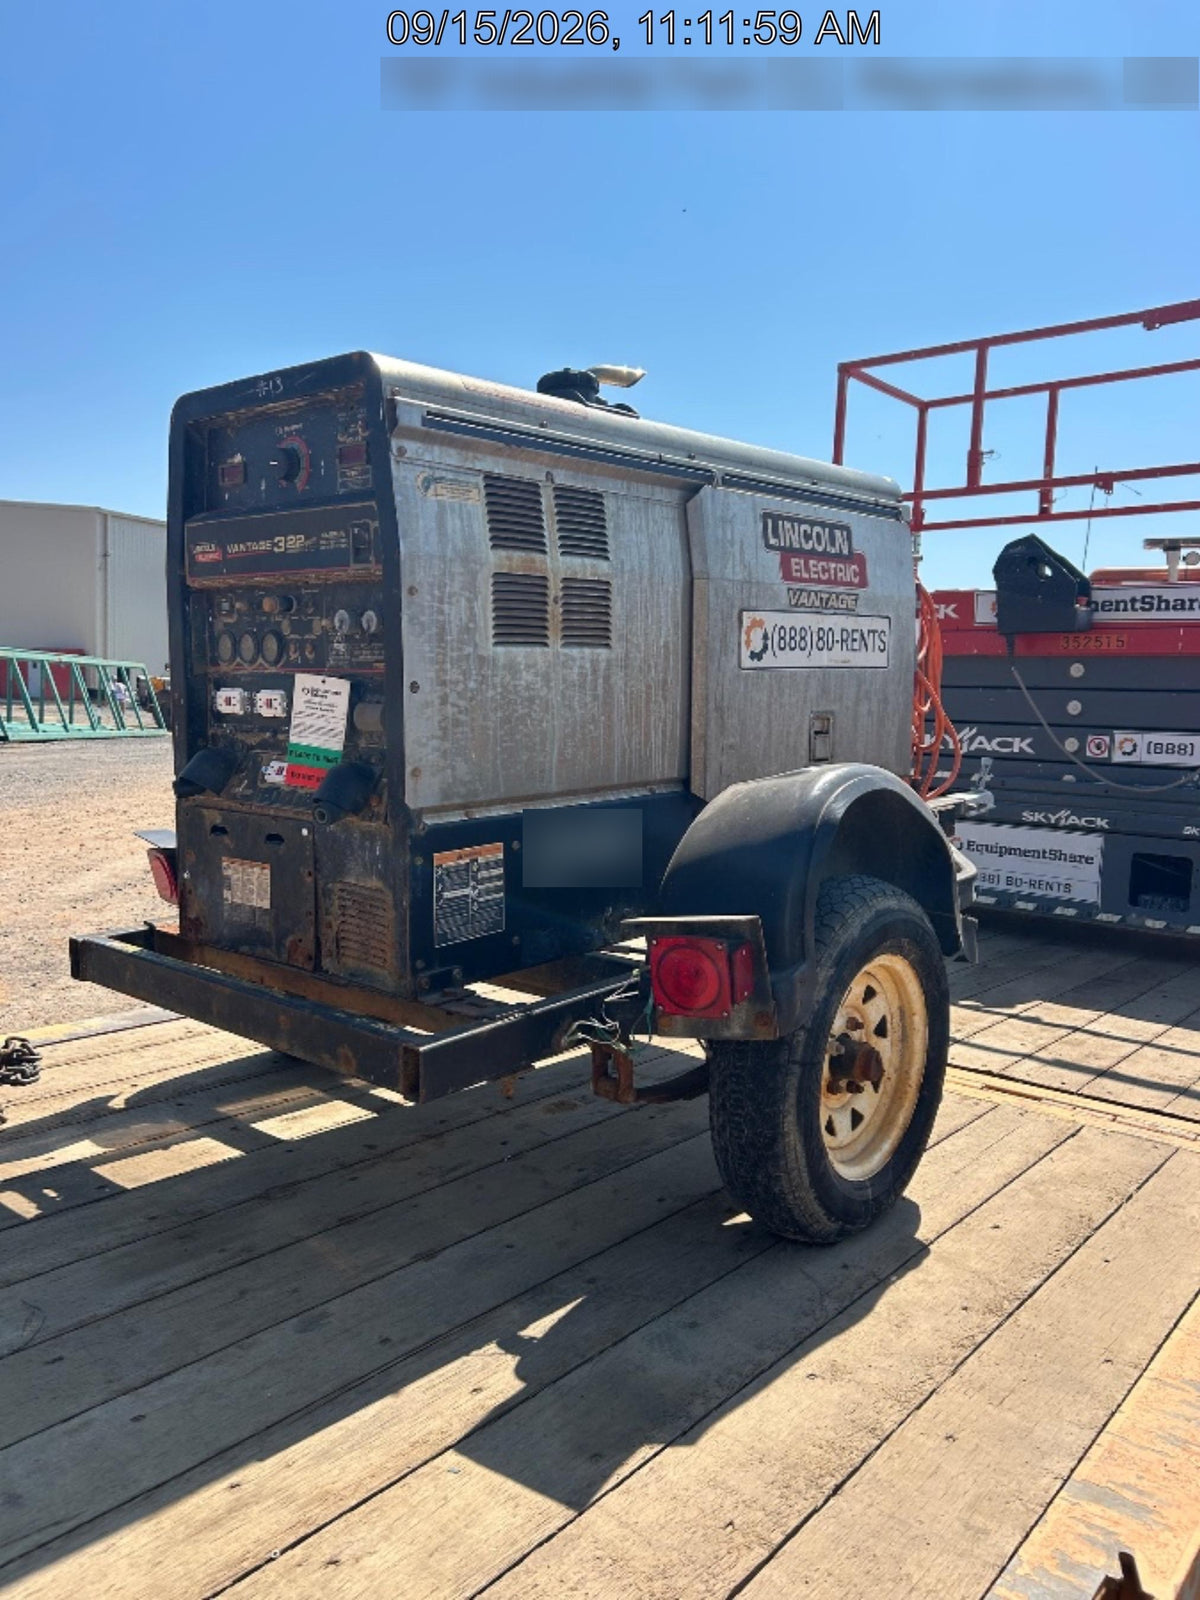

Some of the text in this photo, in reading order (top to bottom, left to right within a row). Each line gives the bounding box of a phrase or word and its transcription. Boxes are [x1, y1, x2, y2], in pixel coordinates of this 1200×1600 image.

[766, 518, 850, 556] LINCOLN
[790, 557, 860, 584] ELECTRIC
[788, 588, 859, 611] VANTAGE
[1021, 809, 1110, 830] SKYJACK
[966, 840, 1095, 866] EquipmentShare
[1006, 875, 1072, 895] 80-RENTS
